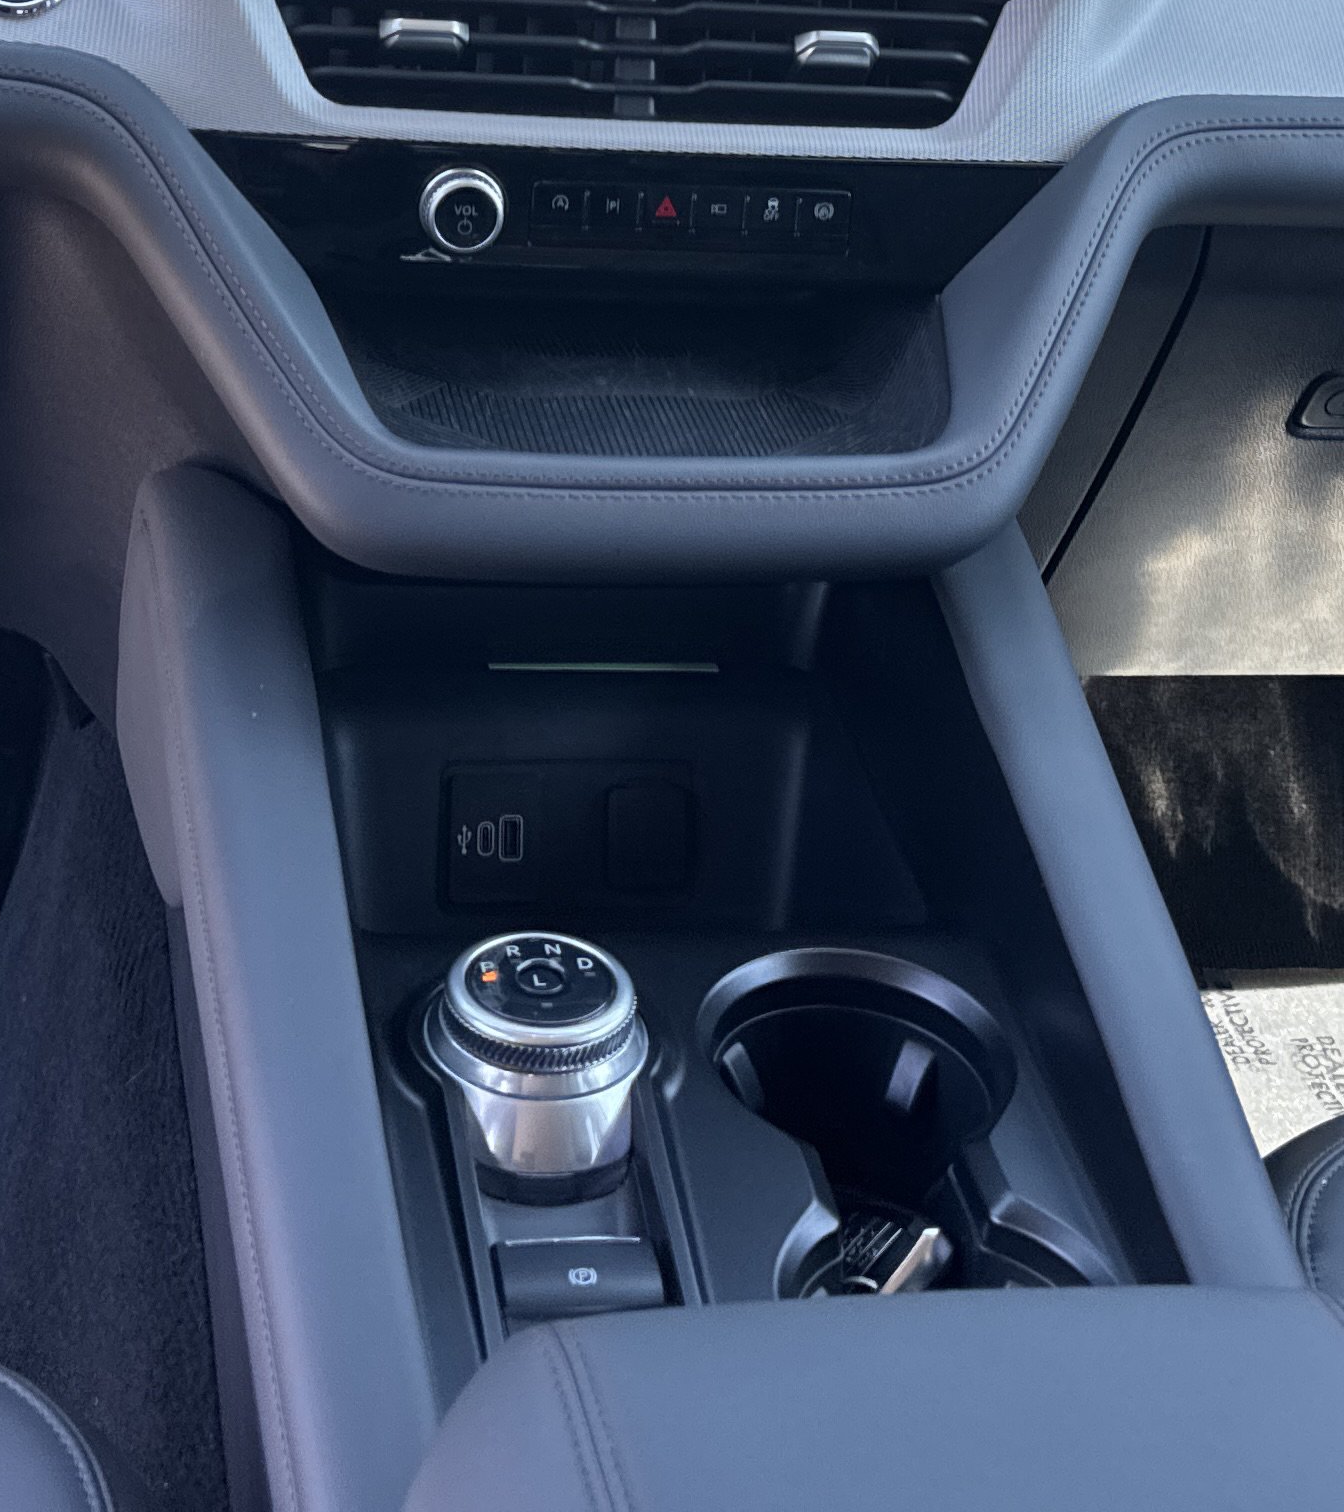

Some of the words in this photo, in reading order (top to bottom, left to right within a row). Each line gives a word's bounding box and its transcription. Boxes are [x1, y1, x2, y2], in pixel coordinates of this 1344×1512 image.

[454, 203, 479, 217] VOL
[506, 944, 522, 957] R
[544, 943, 562, 956] N
[479, 960, 495, 972] P
[576, 957, 594, 970] D
[532, 974, 547, 987] L
